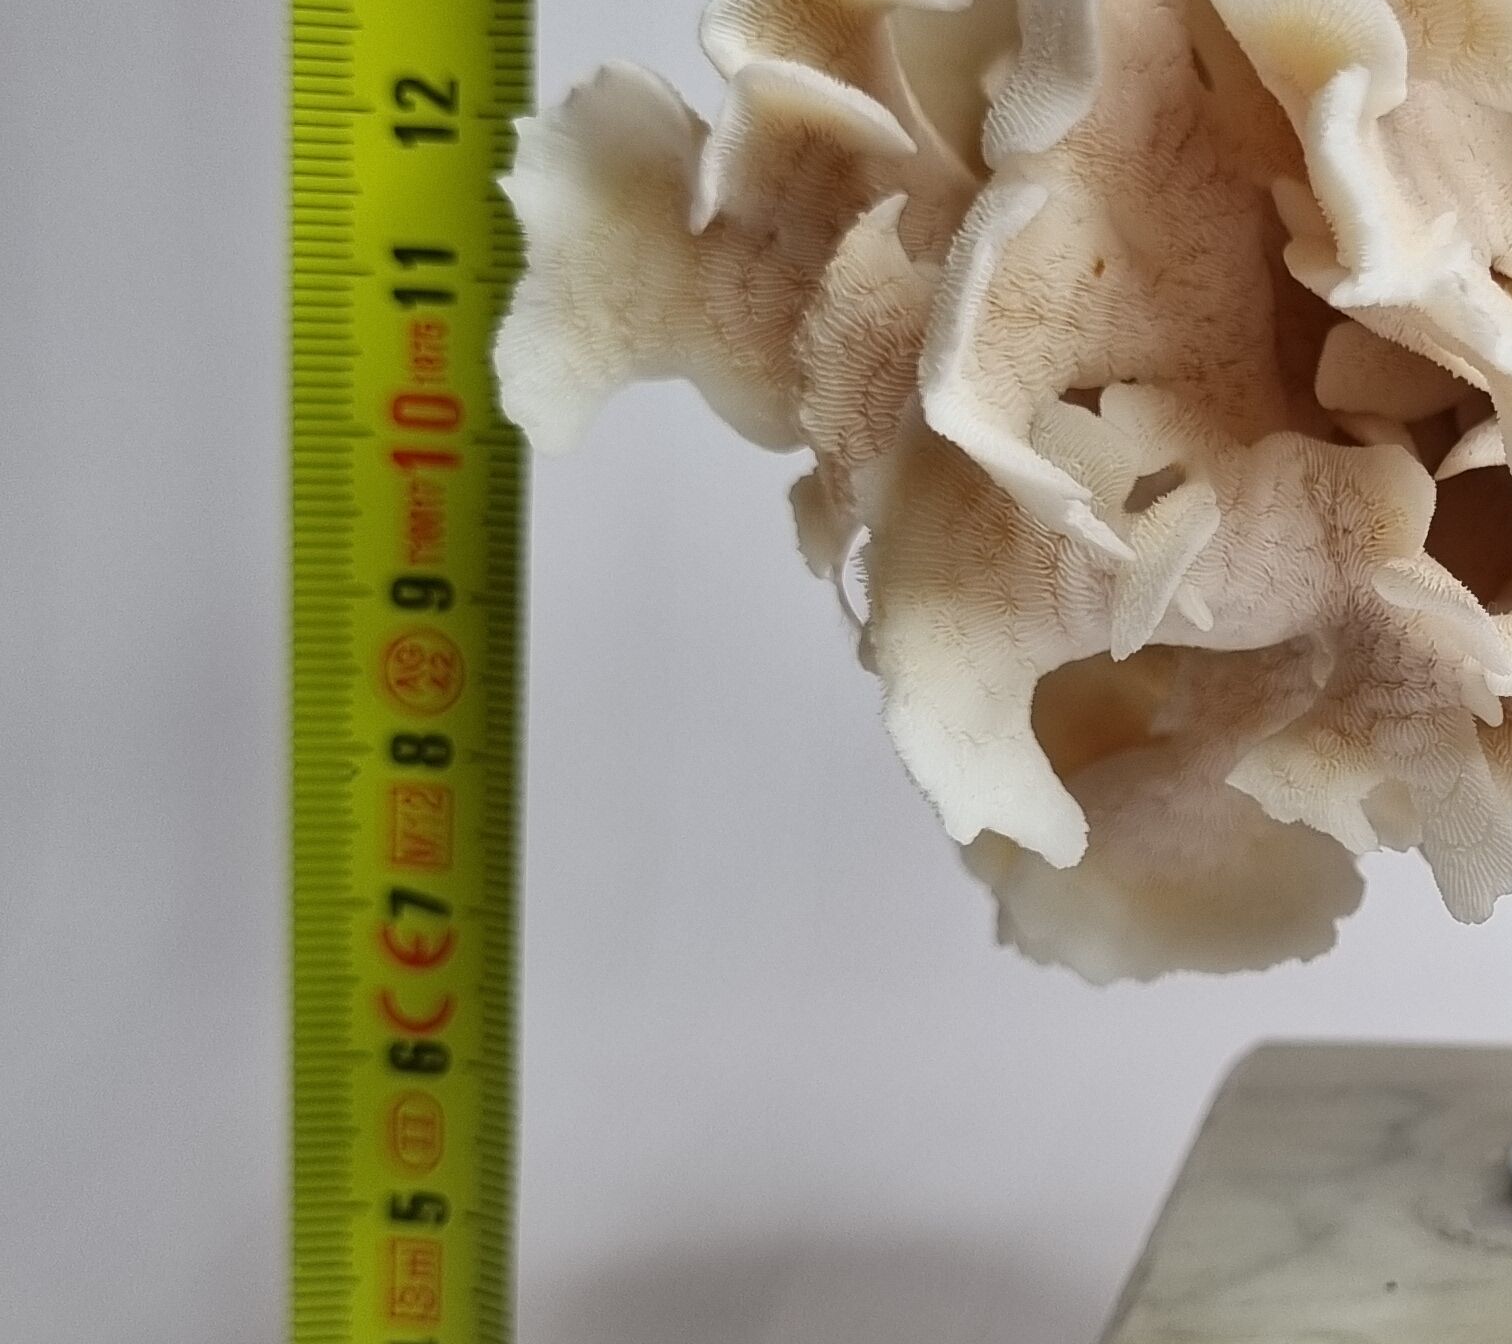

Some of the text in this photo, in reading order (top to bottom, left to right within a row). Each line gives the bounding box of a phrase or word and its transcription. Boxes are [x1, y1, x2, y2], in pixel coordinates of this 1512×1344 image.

[394, 76, 460, 147] 12
[392, 247, 457, 310] 11
[391, 392, 462, 469] 10
[391, 575, 455, 612] 9
[390, 732, 454, 769] 8
[388, 886, 453, 919] 7
[378, 922, 457, 1035] CE
[387, 1040, 451, 1076] 6
[387, 1191, 451, 1228] 5
